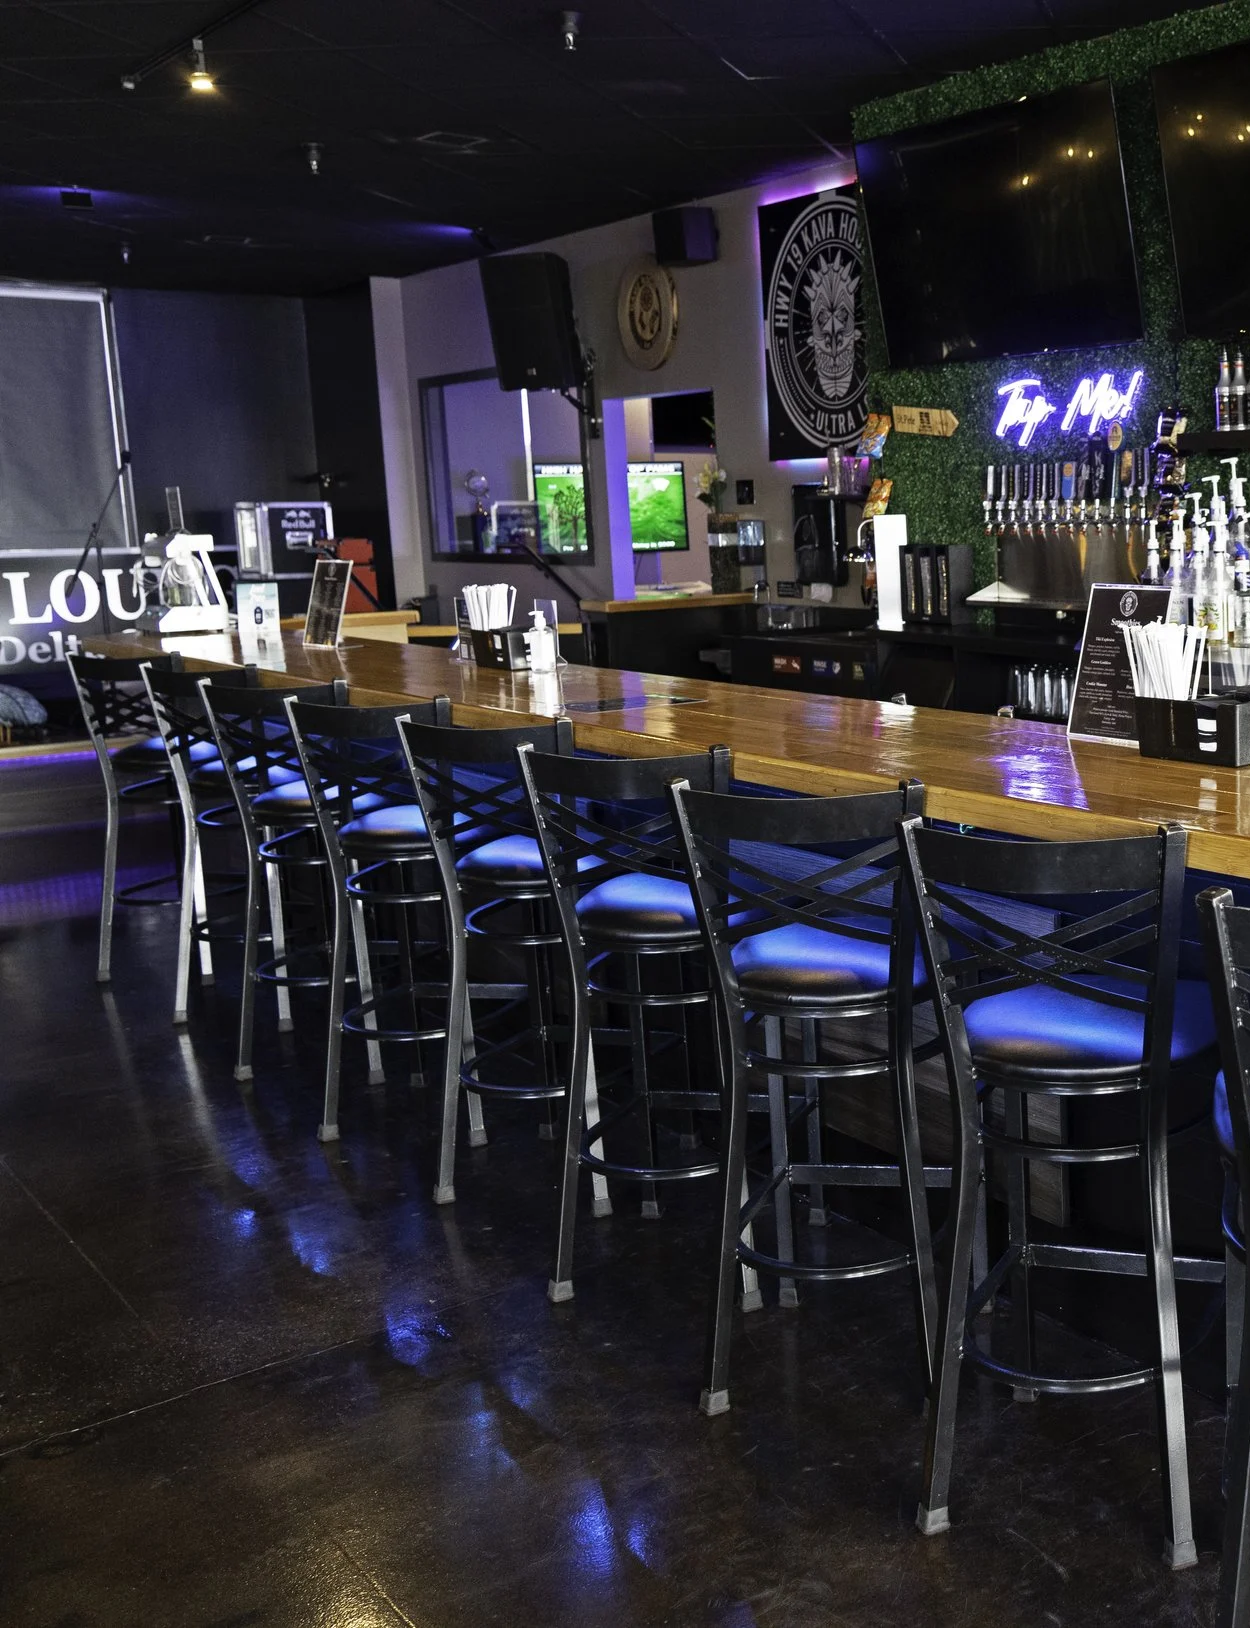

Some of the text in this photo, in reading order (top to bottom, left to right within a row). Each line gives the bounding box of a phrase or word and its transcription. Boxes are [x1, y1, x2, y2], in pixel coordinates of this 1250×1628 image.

[775, 273, 793, 327] HWY
[786, 243, 803, 272] 19
[801, 212, 835, 252] KAVA
[816, 410, 857, 435] ULTRA
[996, 370, 1144, 447] Tap Me!
[2, 568, 147, 625] LOU
[0, 631, 105, 665] Delt
